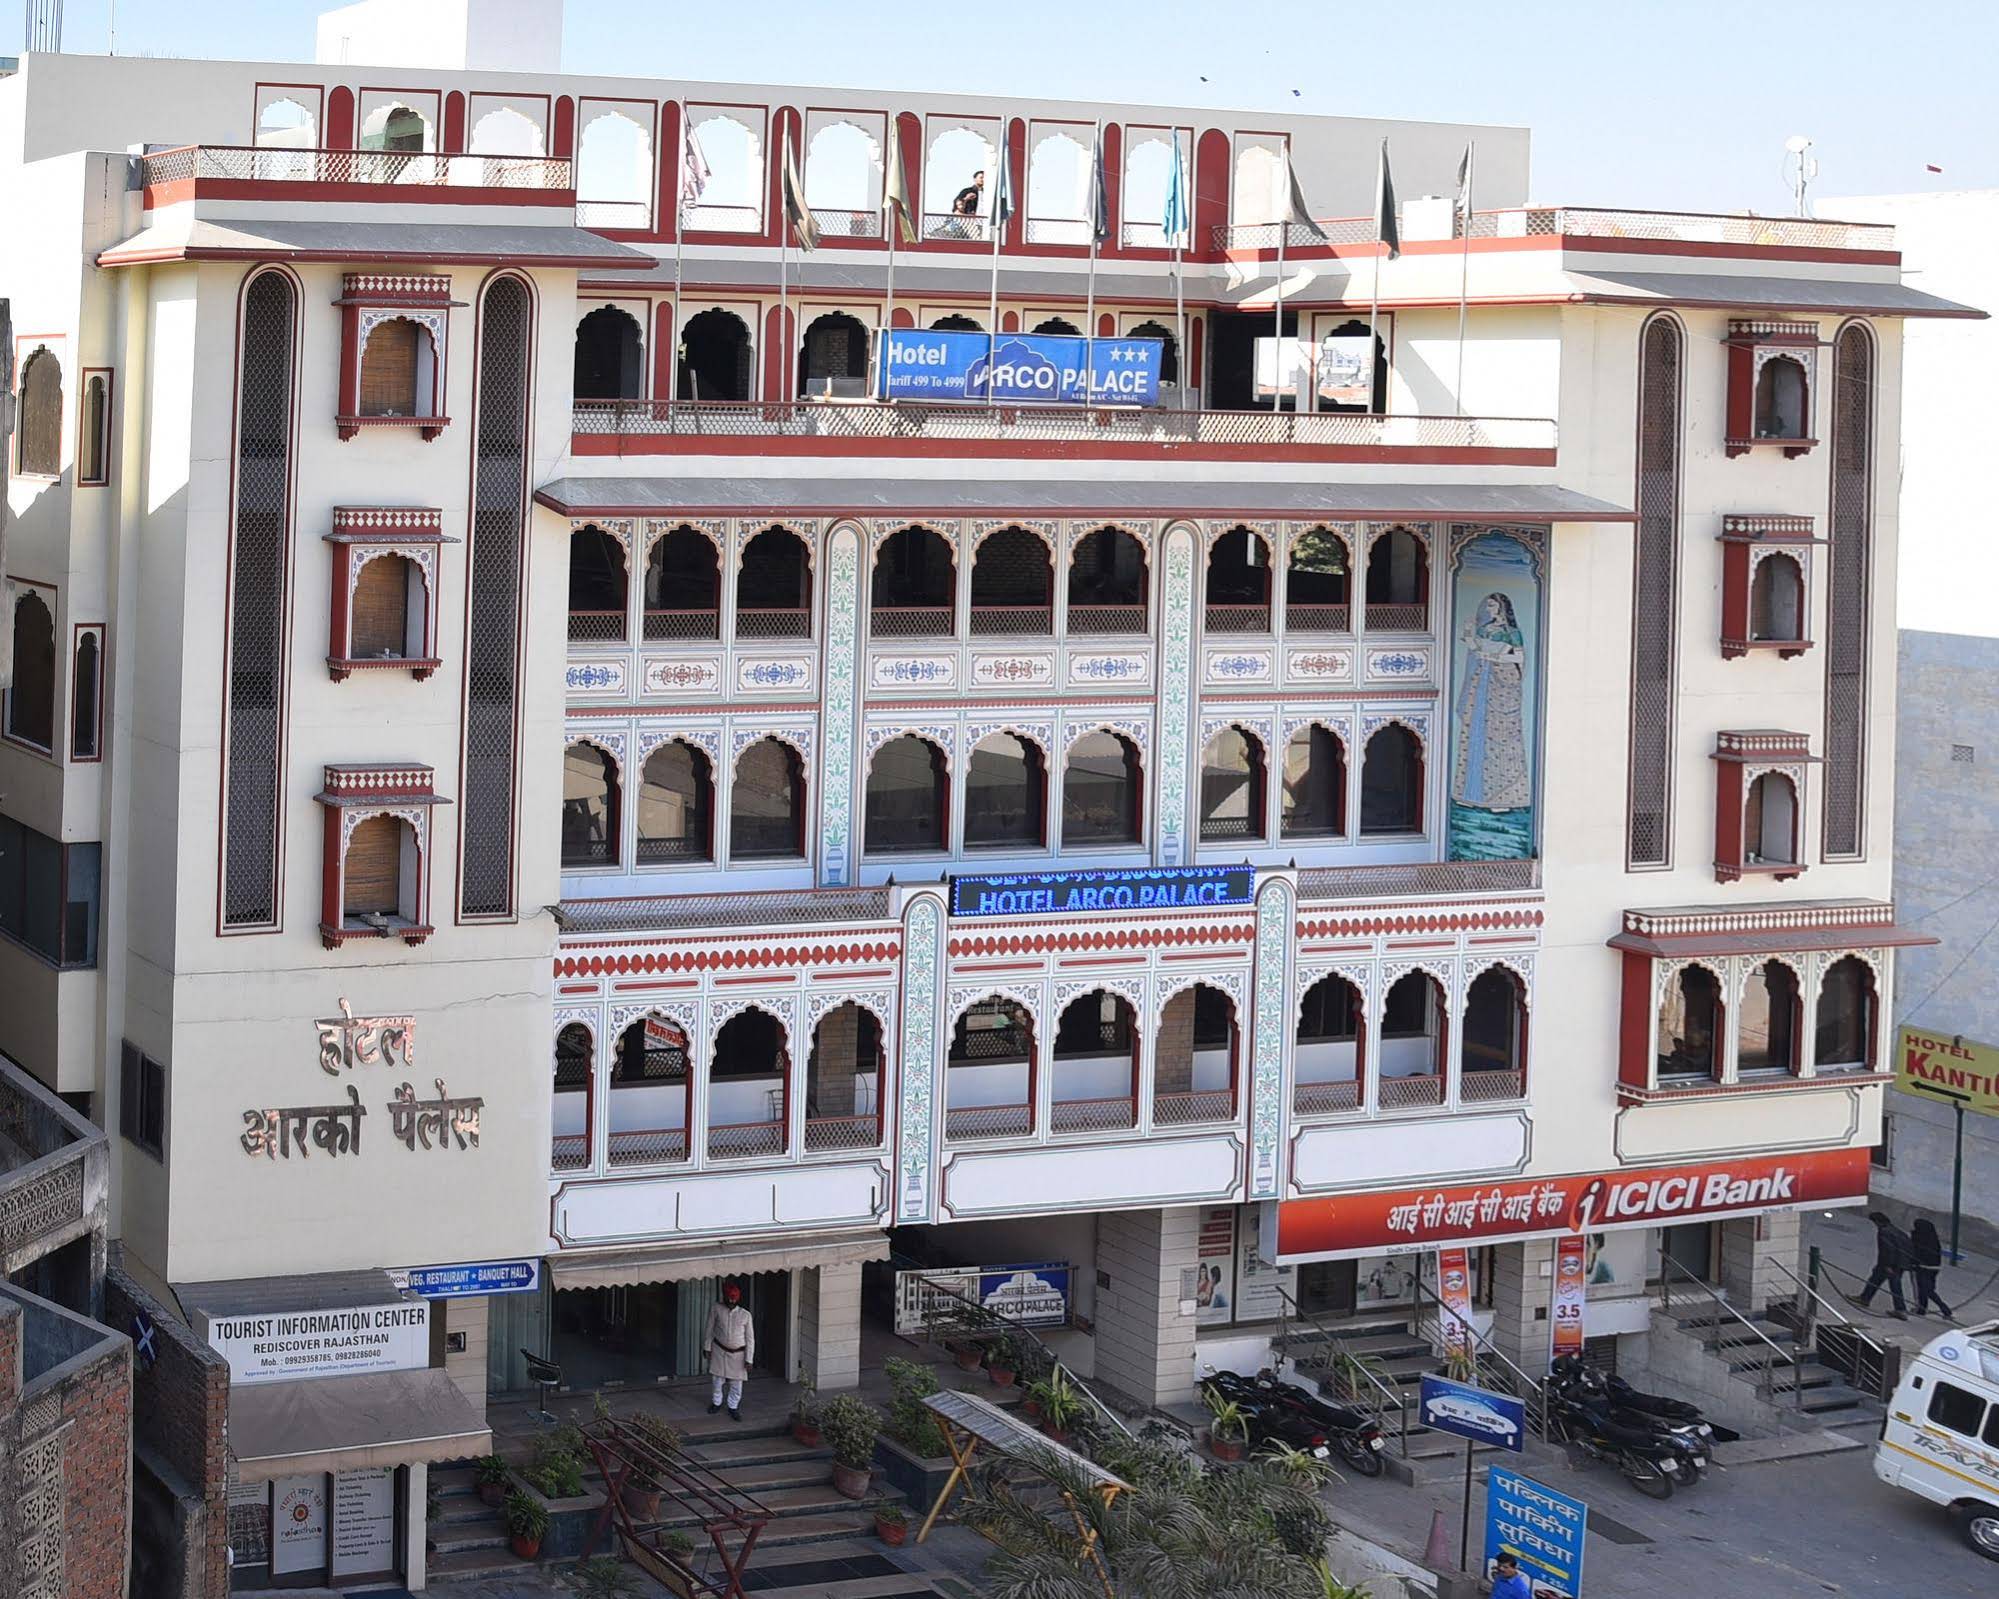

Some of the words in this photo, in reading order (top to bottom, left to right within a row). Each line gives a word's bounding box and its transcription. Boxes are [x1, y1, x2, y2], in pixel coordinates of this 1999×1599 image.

[889, 342, 947, 366] Hotel
[912, 376, 929, 387] 499
[930, 376, 942, 387] To
[943, 377, 965, 388] 4999
[973, 364, 1054, 389] ARCO
[1062, 368, 1149, 394] PALACE
[980, 889, 1054, 913] HOTEL
[1067, 887, 1133, 911] ARCO
[1140, 882, 1229, 906] PALACE
[314, 997, 416, 1076] होटल
[1906, 1034, 1975, 1062] HOTEL
[240, 1084, 367, 1160] आरको
[387, 1078, 485, 1151] पैलेस
[1605, 1176, 1699, 1218] ICICI
[1701, 1167, 1795, 1208] Bank
[1387, 1196, 1423, 1235] आई
[1423, 1193, 1445, 1228] सी
[1444, 1190, 1481, 1229] आई
[1480, 1188, 1502, 1222] सी
[1502, 1185, 1537, 1223] आई
[1537, 1182, 1566, 1217] बैंक
[426, 1270, 470, 1285] RESTAURANT
[478, 1267, 510, 1282] BANQUET
[510, 1265, 528, 1279] HALL
[988, 1301, 1024, 1315] ARCO
[1025, 1299, 1062, 1313] PALACE
[1556, 1303, 1581, 1319] 3.5
[216, 1319, 273, 1340] TOURIST
[277, 1311, 370, 1337] INFORMATION
[375, 1308, 425, 1328] CENTER
[253, 1339, 320, 1354] REDISCOVER
[324, 1333, 389, 1348] RAJASTHAN
[261, 1358, 279, 1367] Mob.
[1493, 1474, 1582, 1521] पब्लिक
[1494, 1519, 1574, 1564] सुविधा
